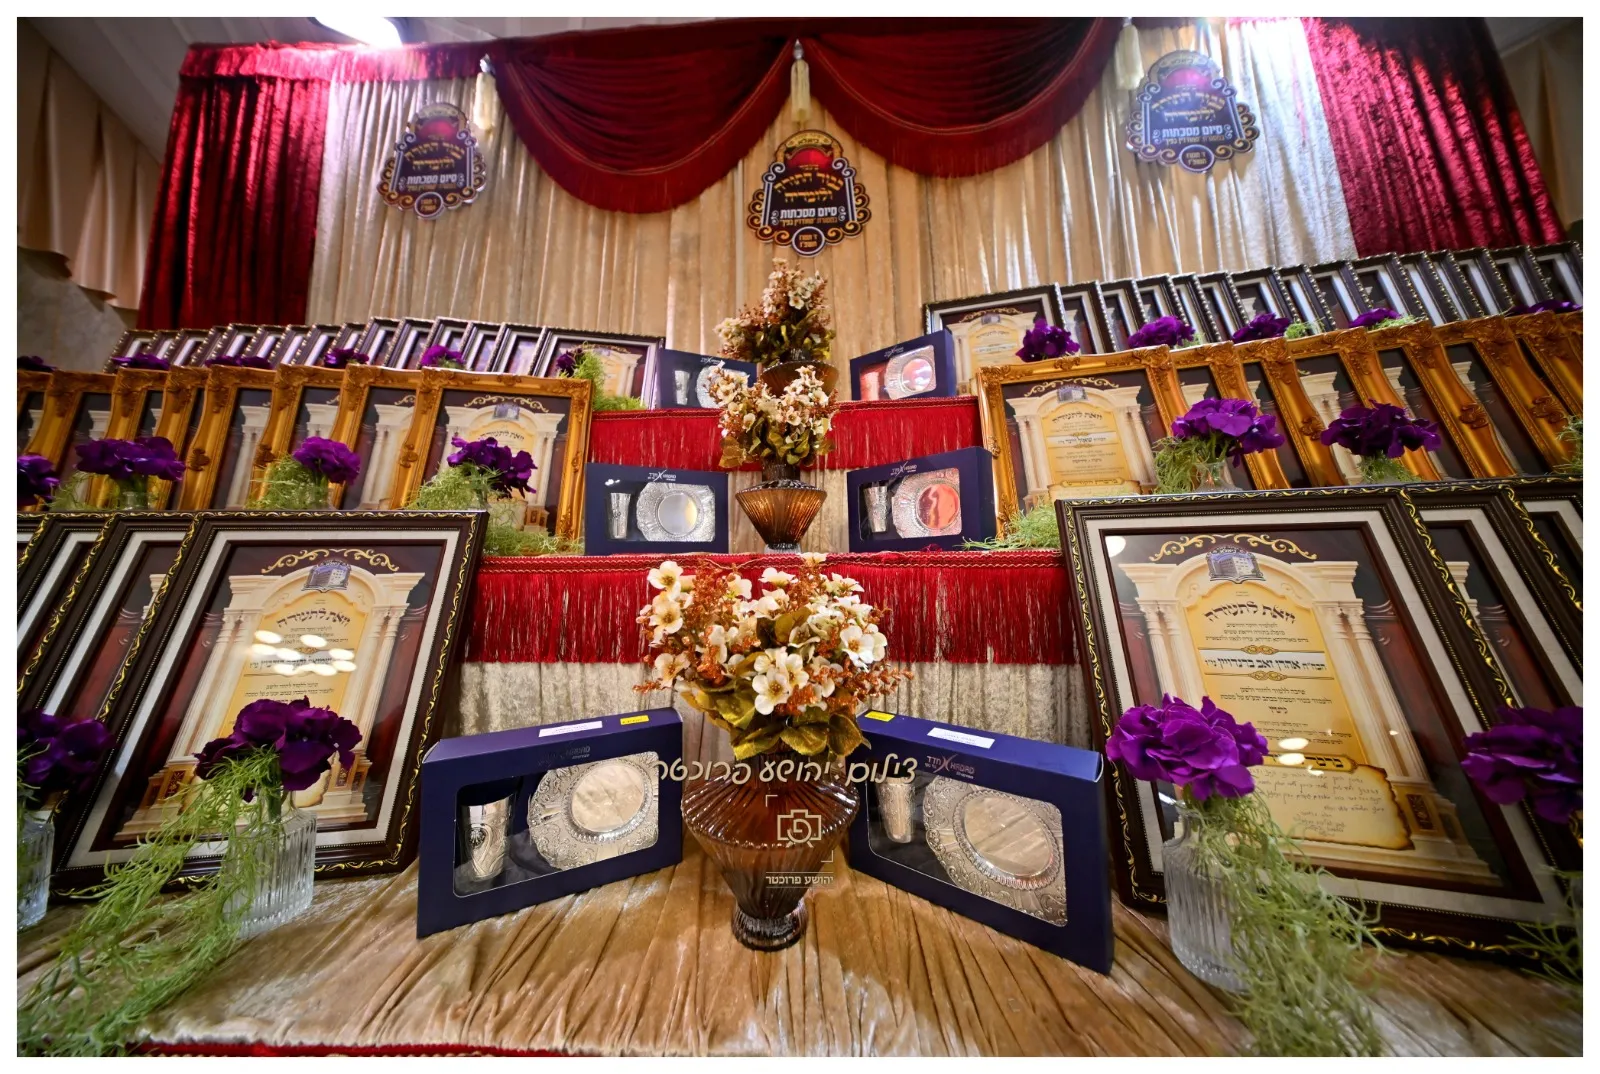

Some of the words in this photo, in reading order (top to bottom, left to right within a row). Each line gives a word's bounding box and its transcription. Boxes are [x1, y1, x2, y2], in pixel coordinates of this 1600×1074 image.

[1162, 127, 1200, 138] מסכתות
[1203, 125, 1222, 135] סיום
[407, 175, 438, 185] מסכתות
[440, 173, 457, 183] סיום
[780, 207, 817, 219] מסכתות
[818, 206, 838, 217] סיום
[1204, 600, 1258, 623] לתעודה
[1262, 604, 1296, 624] וזאת
[277, 608, 326, 628] לתעודה
[326, 610, 351, 627] וזאת
[1256, 659, 1273, 668] זאב
[1275, 659, 1301, 671] אהרן
[950, 762, 975, 774] HADAD
